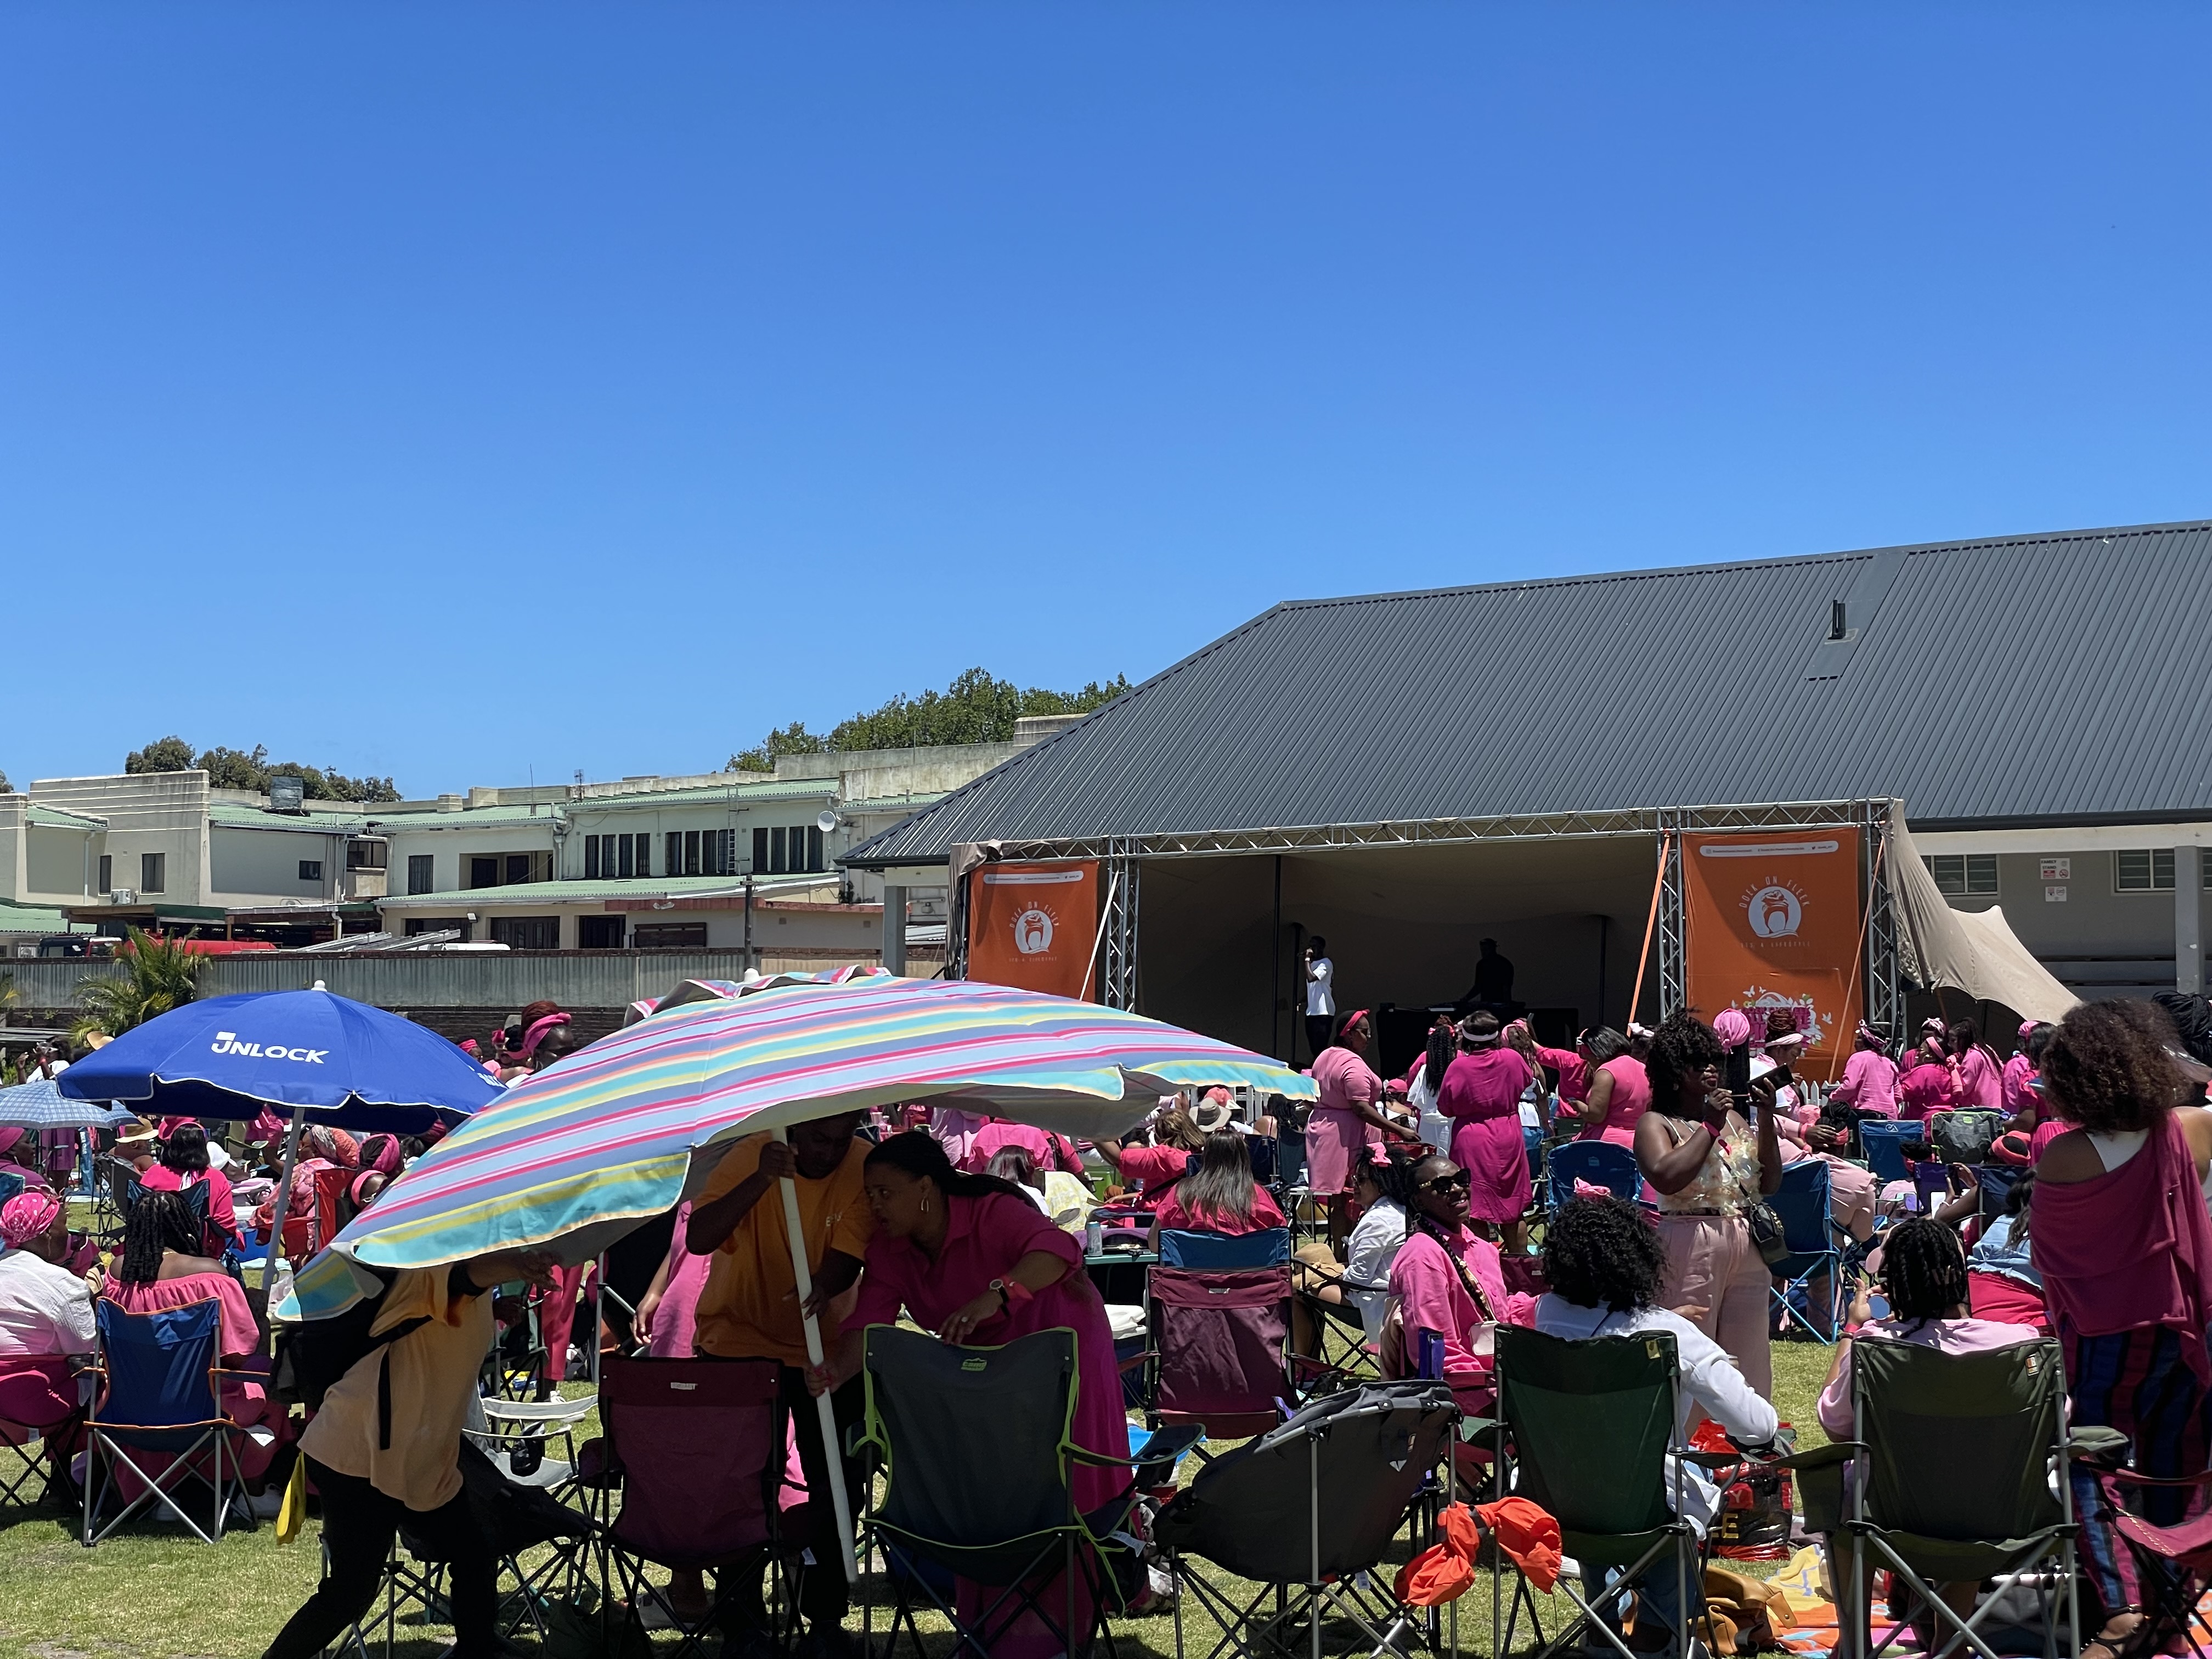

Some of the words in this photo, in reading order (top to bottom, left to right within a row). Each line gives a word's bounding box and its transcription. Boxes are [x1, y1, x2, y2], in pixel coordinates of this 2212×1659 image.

[1739, 883, 1758, 909] DOEK
[1765, 876, 1778, 885] ON
[1786, 879, 1810, 906] FLEEK
